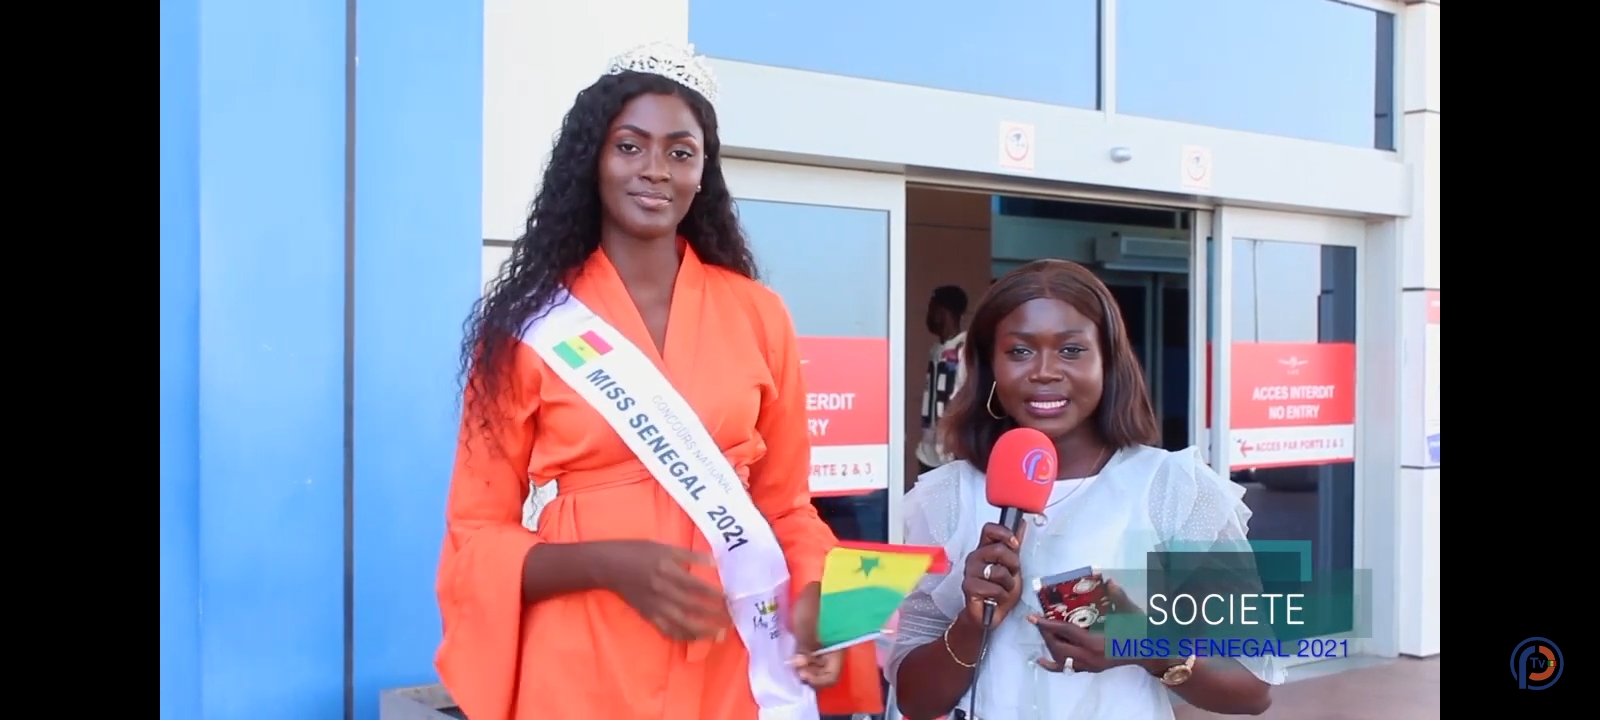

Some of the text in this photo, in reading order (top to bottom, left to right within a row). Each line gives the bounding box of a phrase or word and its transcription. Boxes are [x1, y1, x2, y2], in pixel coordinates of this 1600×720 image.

[1253, 385, 1335, 400] ACCES INTERDIT
[1268, 404, 1320, 420] NO ENTRY
[652, 394, 697, 451] CONCOURS
[585, 368, 748, 551] MISS SENEGAL 2021
[841, 463, 848, 476] 2
[852, 462, 860, 475] &
[864, 461, 872, 475] 3
